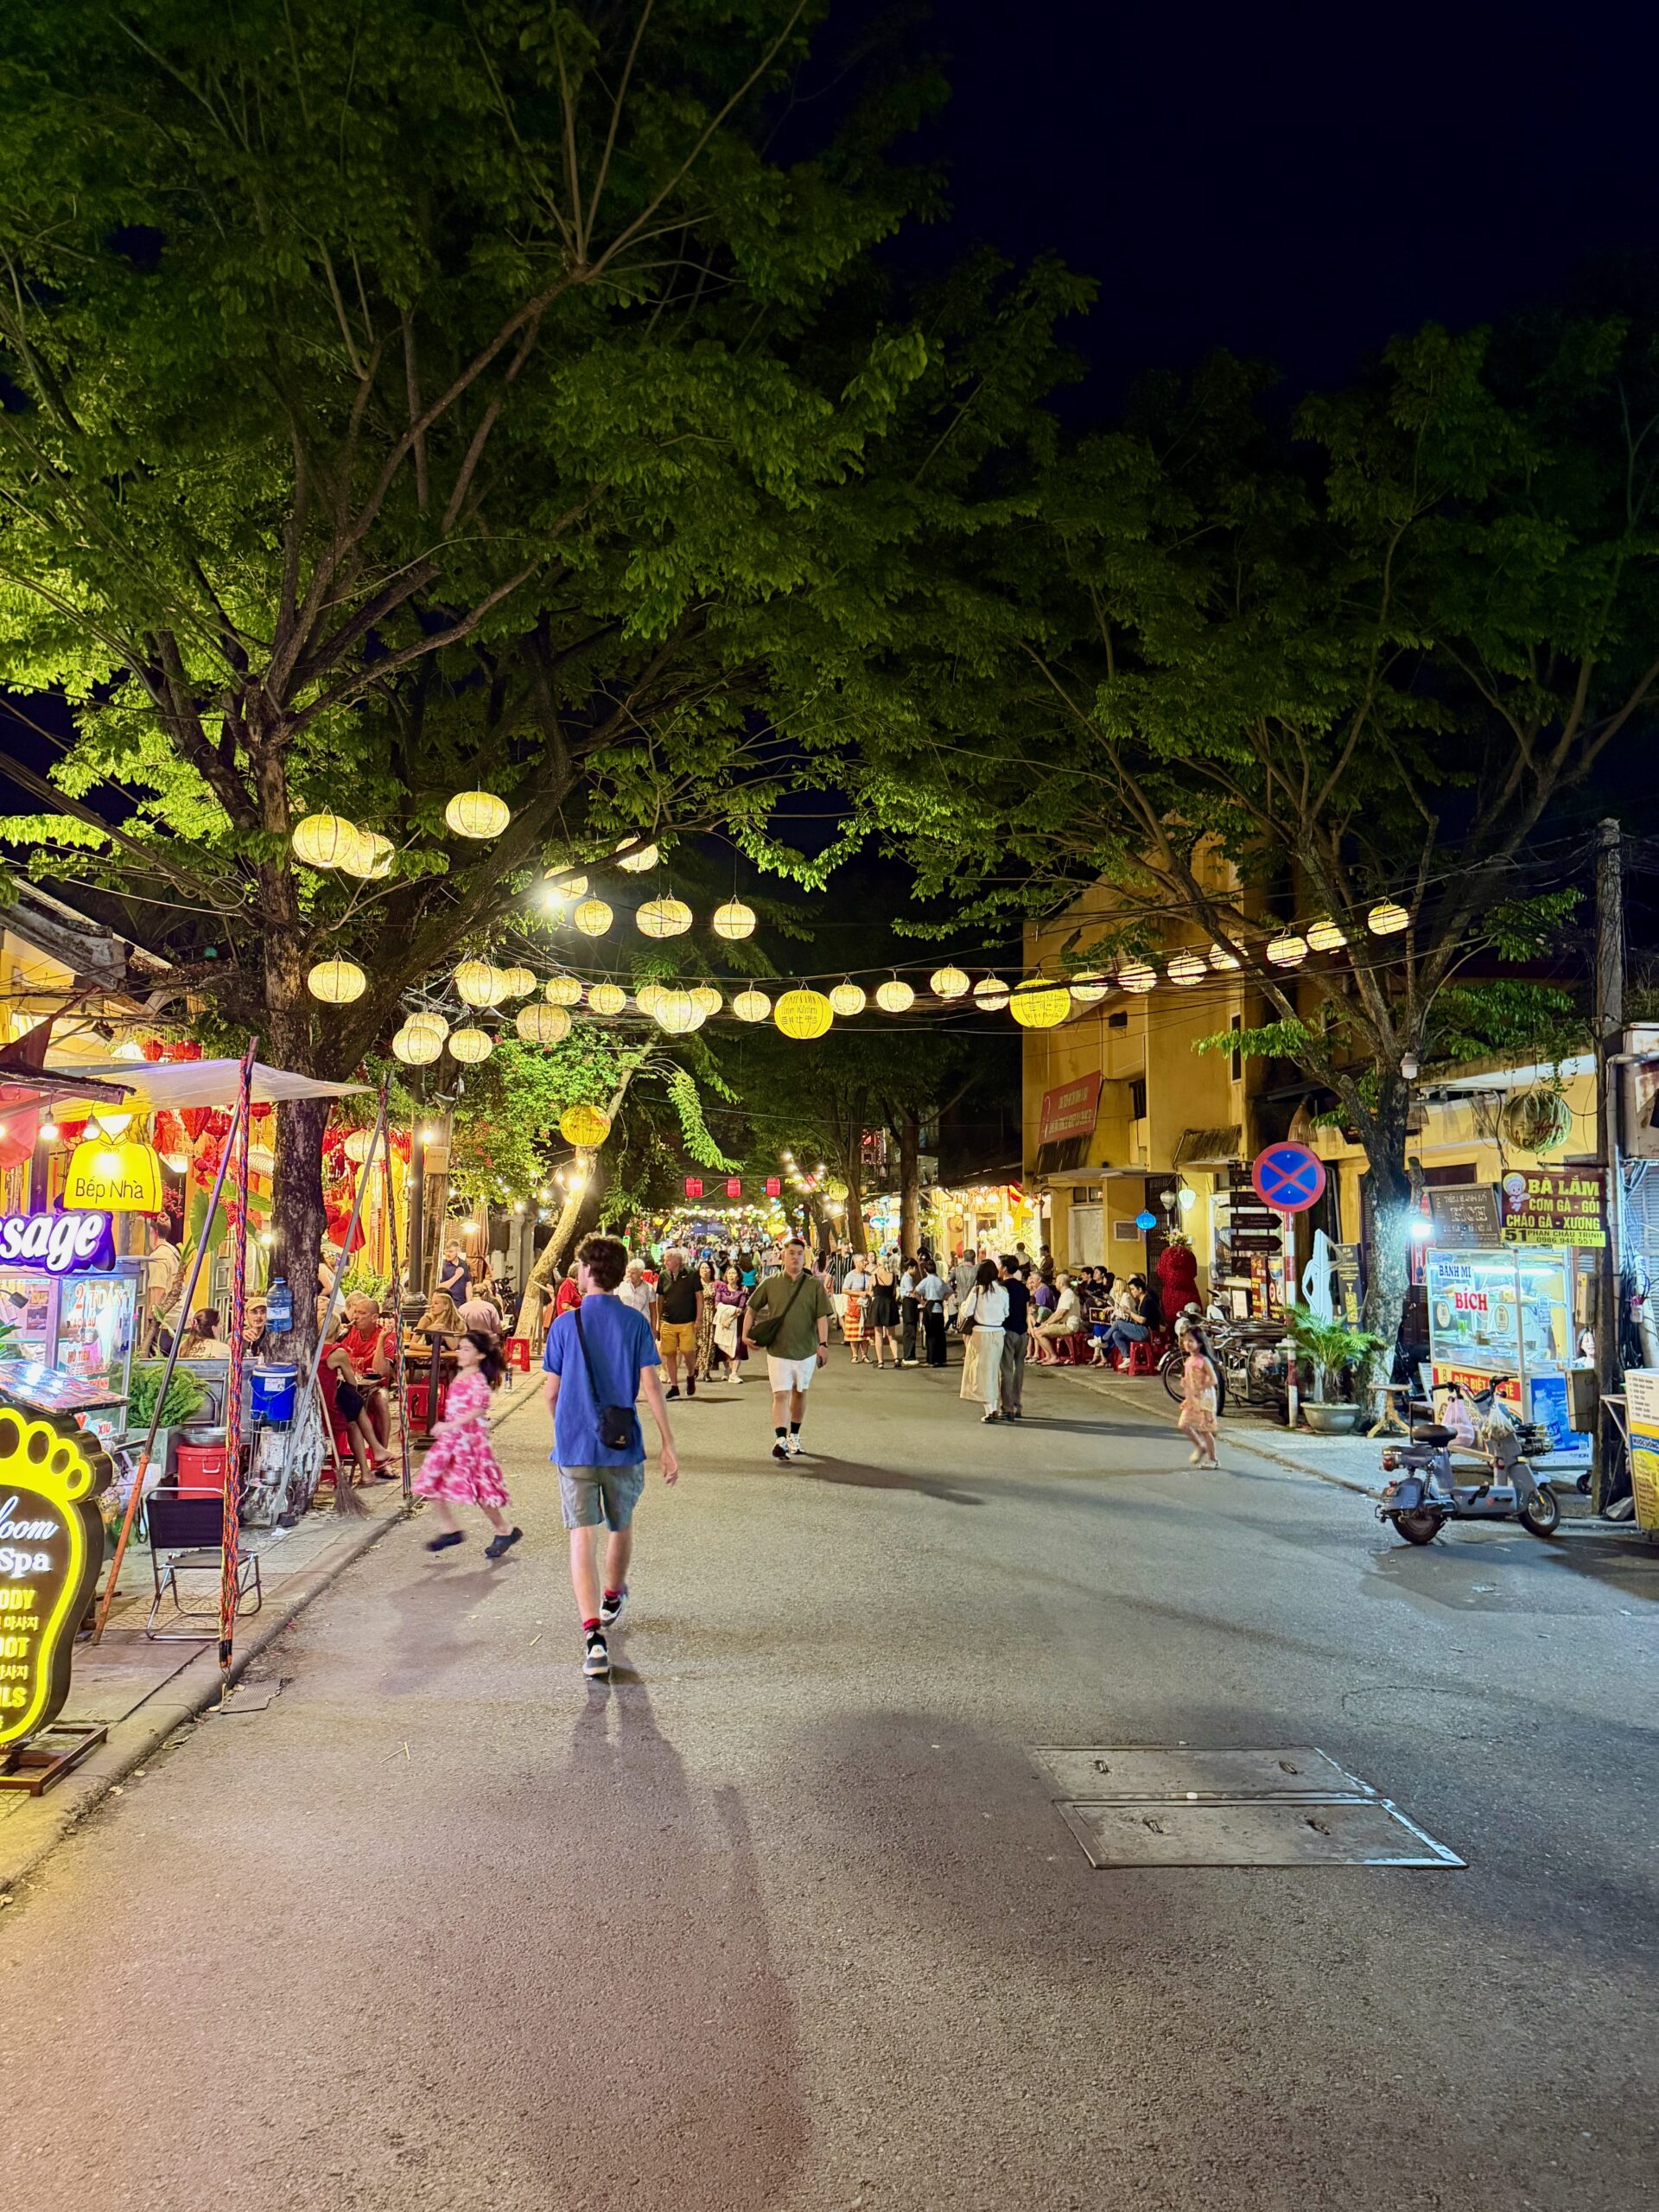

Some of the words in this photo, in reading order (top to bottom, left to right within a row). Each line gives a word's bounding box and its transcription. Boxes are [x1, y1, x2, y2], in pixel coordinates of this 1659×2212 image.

[75, 1176, 105, 1204] Bếp
[110, 1179, 143, 1199] Nhà
[1528, 1177, 1553, 1194] BÀ
[1558, 1175, 1600, 1196] LẮM
[1529, 1198, 1554, 1211] CƠM
[1556, 1198, 1571, 1212] GÀ
[1581, 1197, 1600, 1213] GỎI
[1506, 1212, 1535, 1228] CHÁO
[1538, 1213, 1553, 1229] GÀ
[1563, 1216, 1600, 1230] XƯƠNG
[0, 1214, 104, 1272] sage
[1504, 1229, 1527, 1242] 51
[1439, 1262, 1459, 1277] BÁNH
[1454, 1287, 1488, 1311] BÍCH
[0, 1548, 53, 1579] Spa
